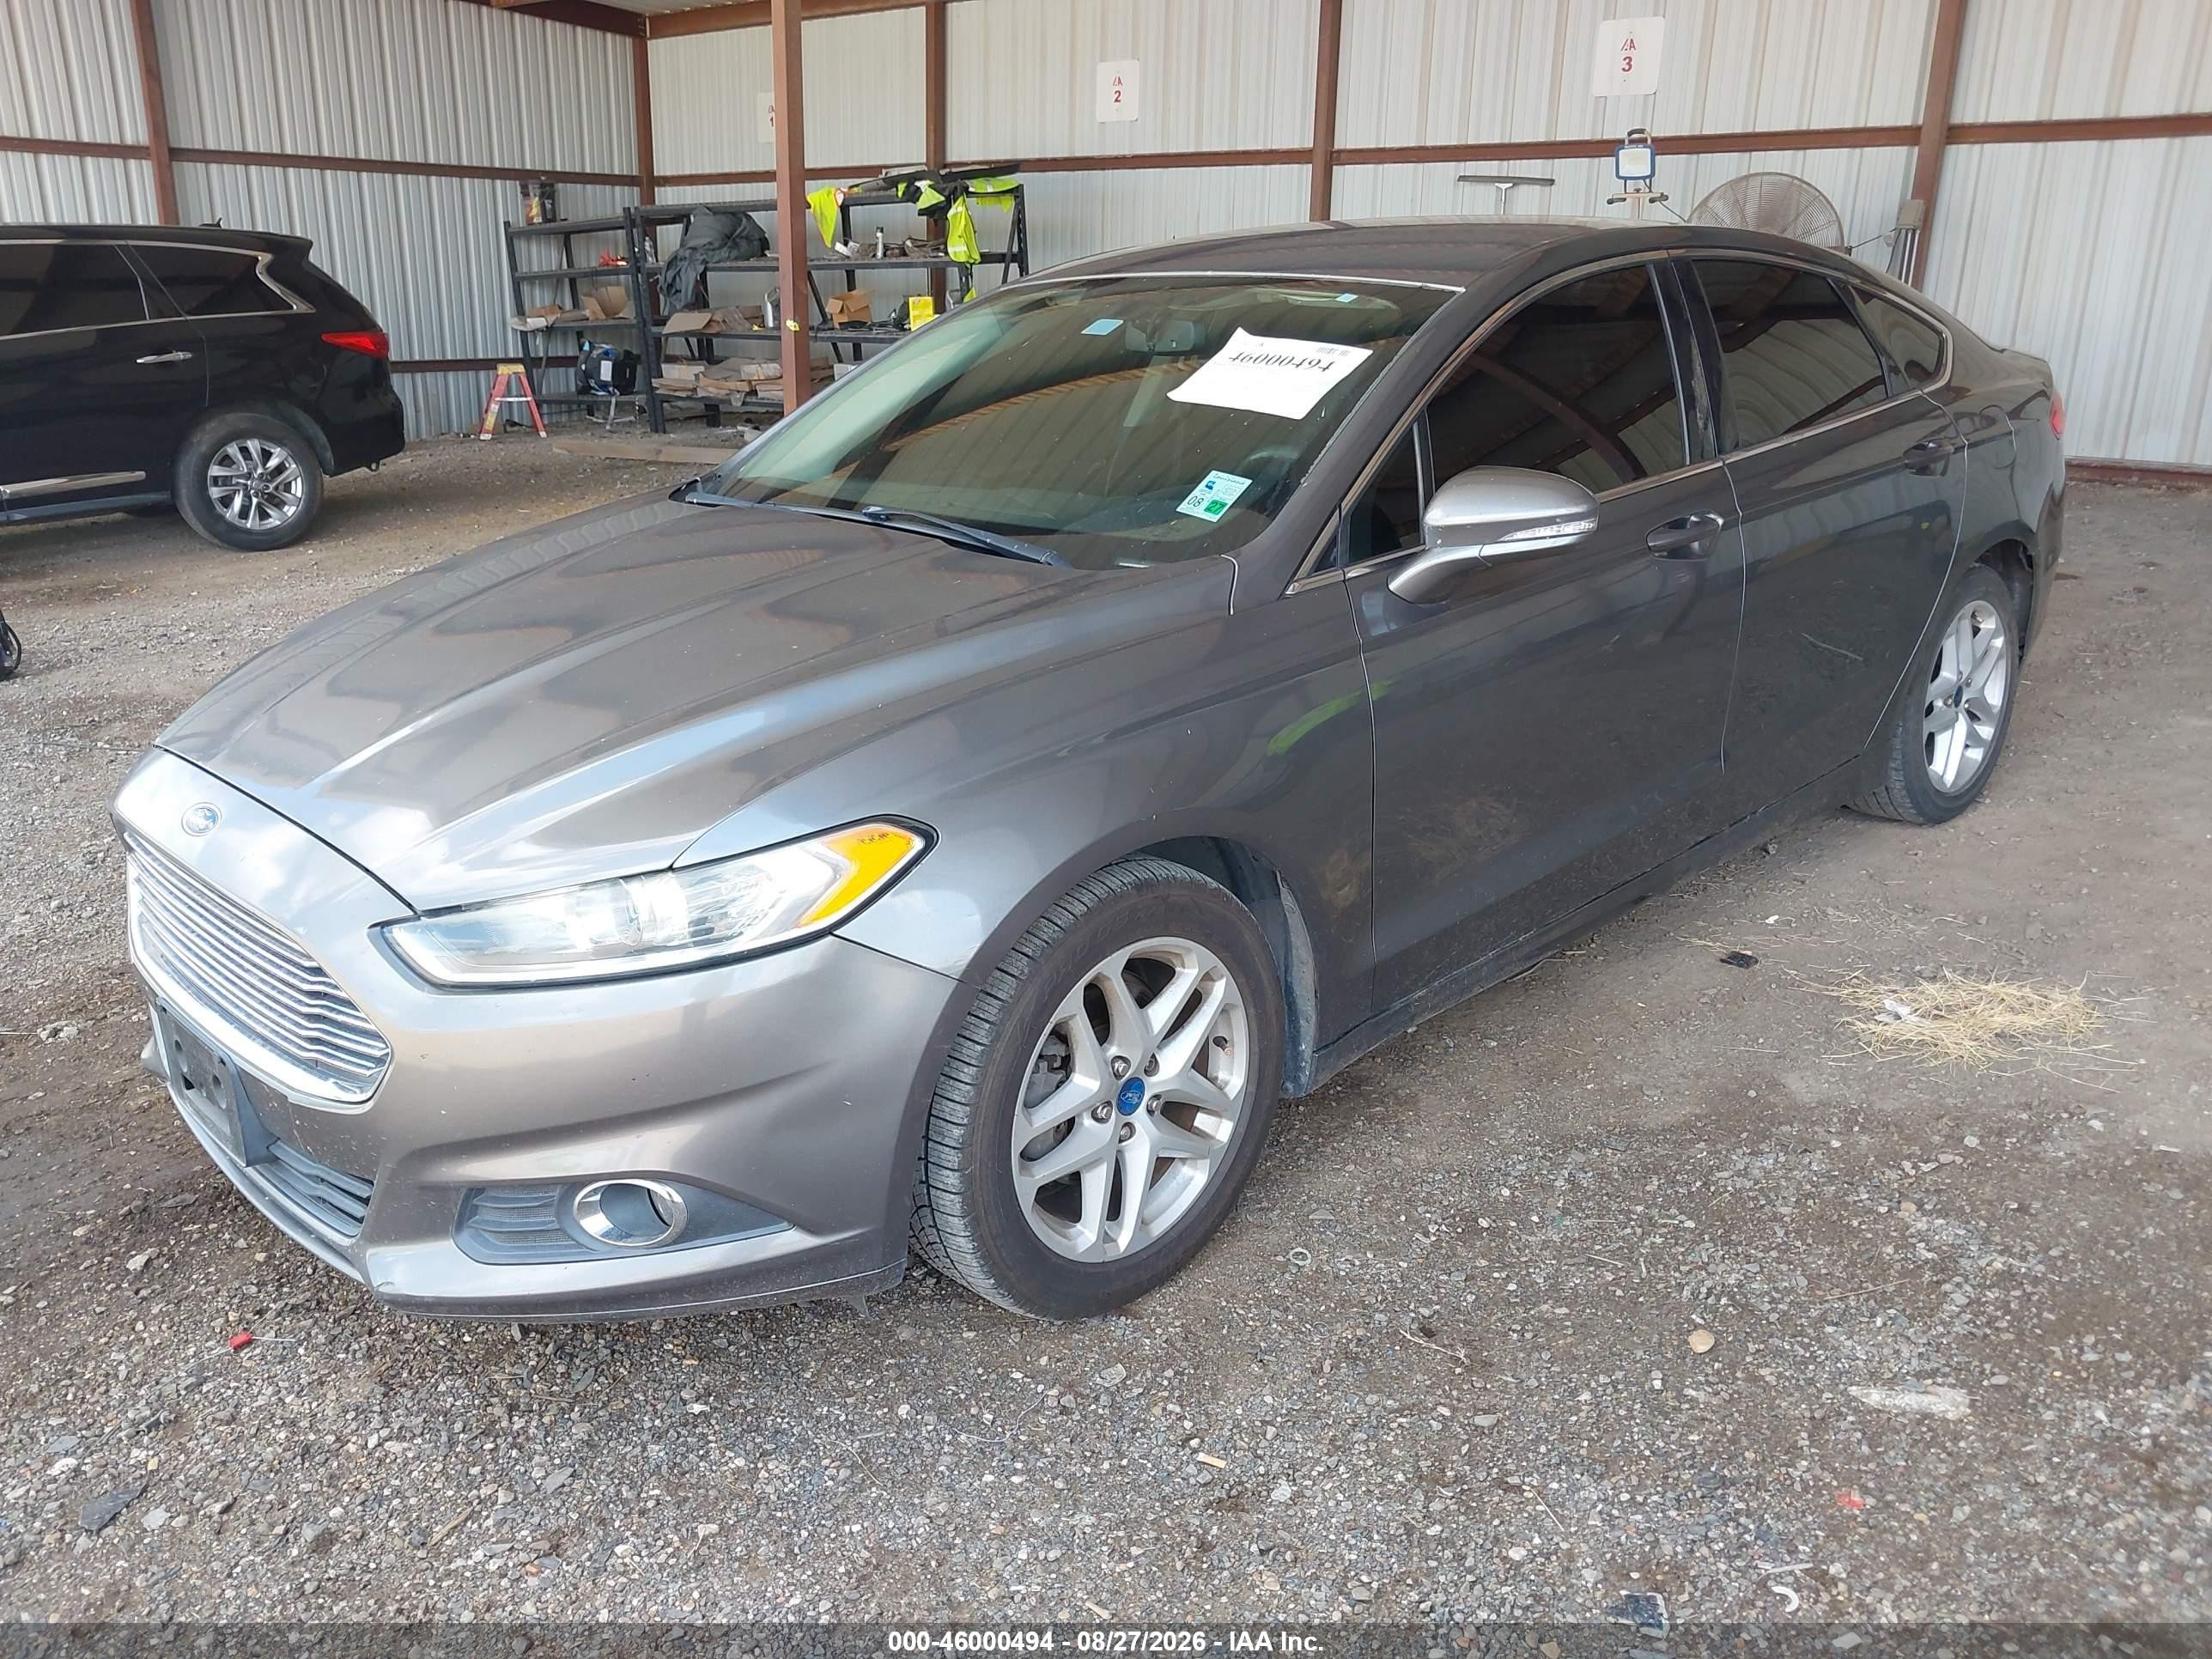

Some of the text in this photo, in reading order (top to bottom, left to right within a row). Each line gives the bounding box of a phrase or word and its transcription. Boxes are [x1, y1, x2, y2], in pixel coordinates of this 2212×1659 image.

[1620, 56, 1633, 72] 3
[1114, 90, 1121, 103] 2
[1229, 352, 1336, 372] 46000494
[1187, 495, 1204, 507] 08
[1207, 501, 1226, 514] 27
